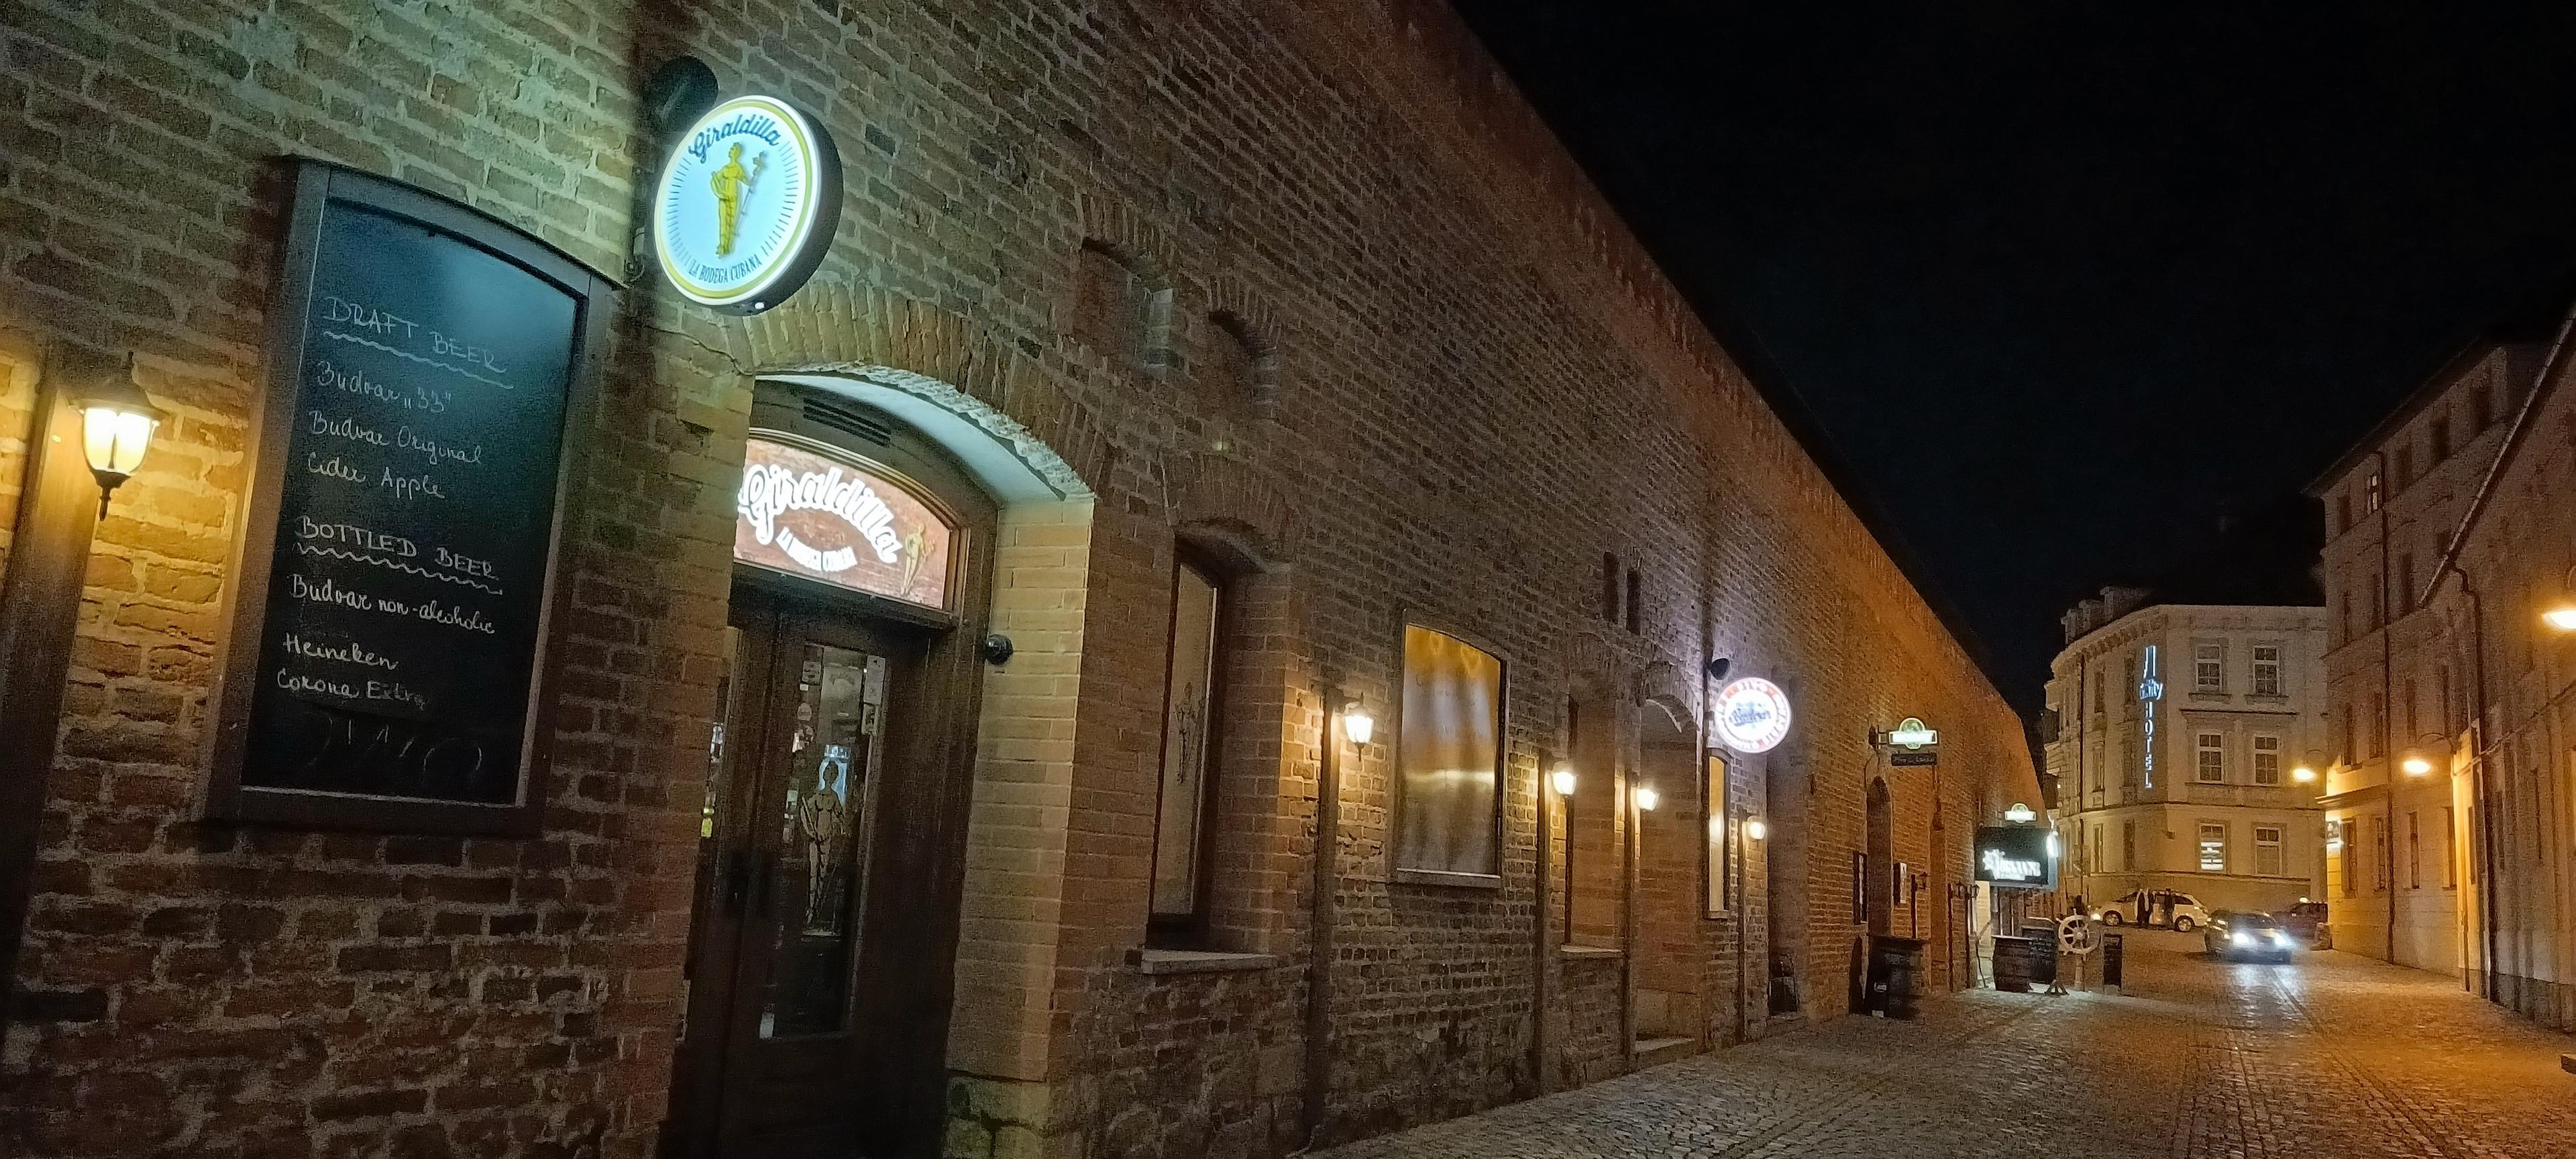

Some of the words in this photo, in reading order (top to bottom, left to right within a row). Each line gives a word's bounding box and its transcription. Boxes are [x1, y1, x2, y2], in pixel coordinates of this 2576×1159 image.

[688, 114, 782, 164] Giraldilla
[688, 259, 700, 278] LA
[698, 264, 729, 284] BODEGA
[731, 253, 763, 281] CUBANA
[322, 296, 419, 338] DRAFT
[429, 331, 507, 374] BEER
[315, 360, 400, 402] Budvar
[309, 410, 391, 446] Budvar
[397, 425, 482, 465] Original
[307, 451, 366, 483] Cider
[380, 466, 445, 500] Apple
[738, 464, 904, 563] Giraldilla
[294, 516, 417, 557] BOTTLED
[434, 547, 500, 581] BEER
[290, 573, 372, 610] Budvar
[282, 633, 400, 671] Heineken
[277, 667, 360, 699] Corona
[2144, 701, 2154, 789] HOTEL
